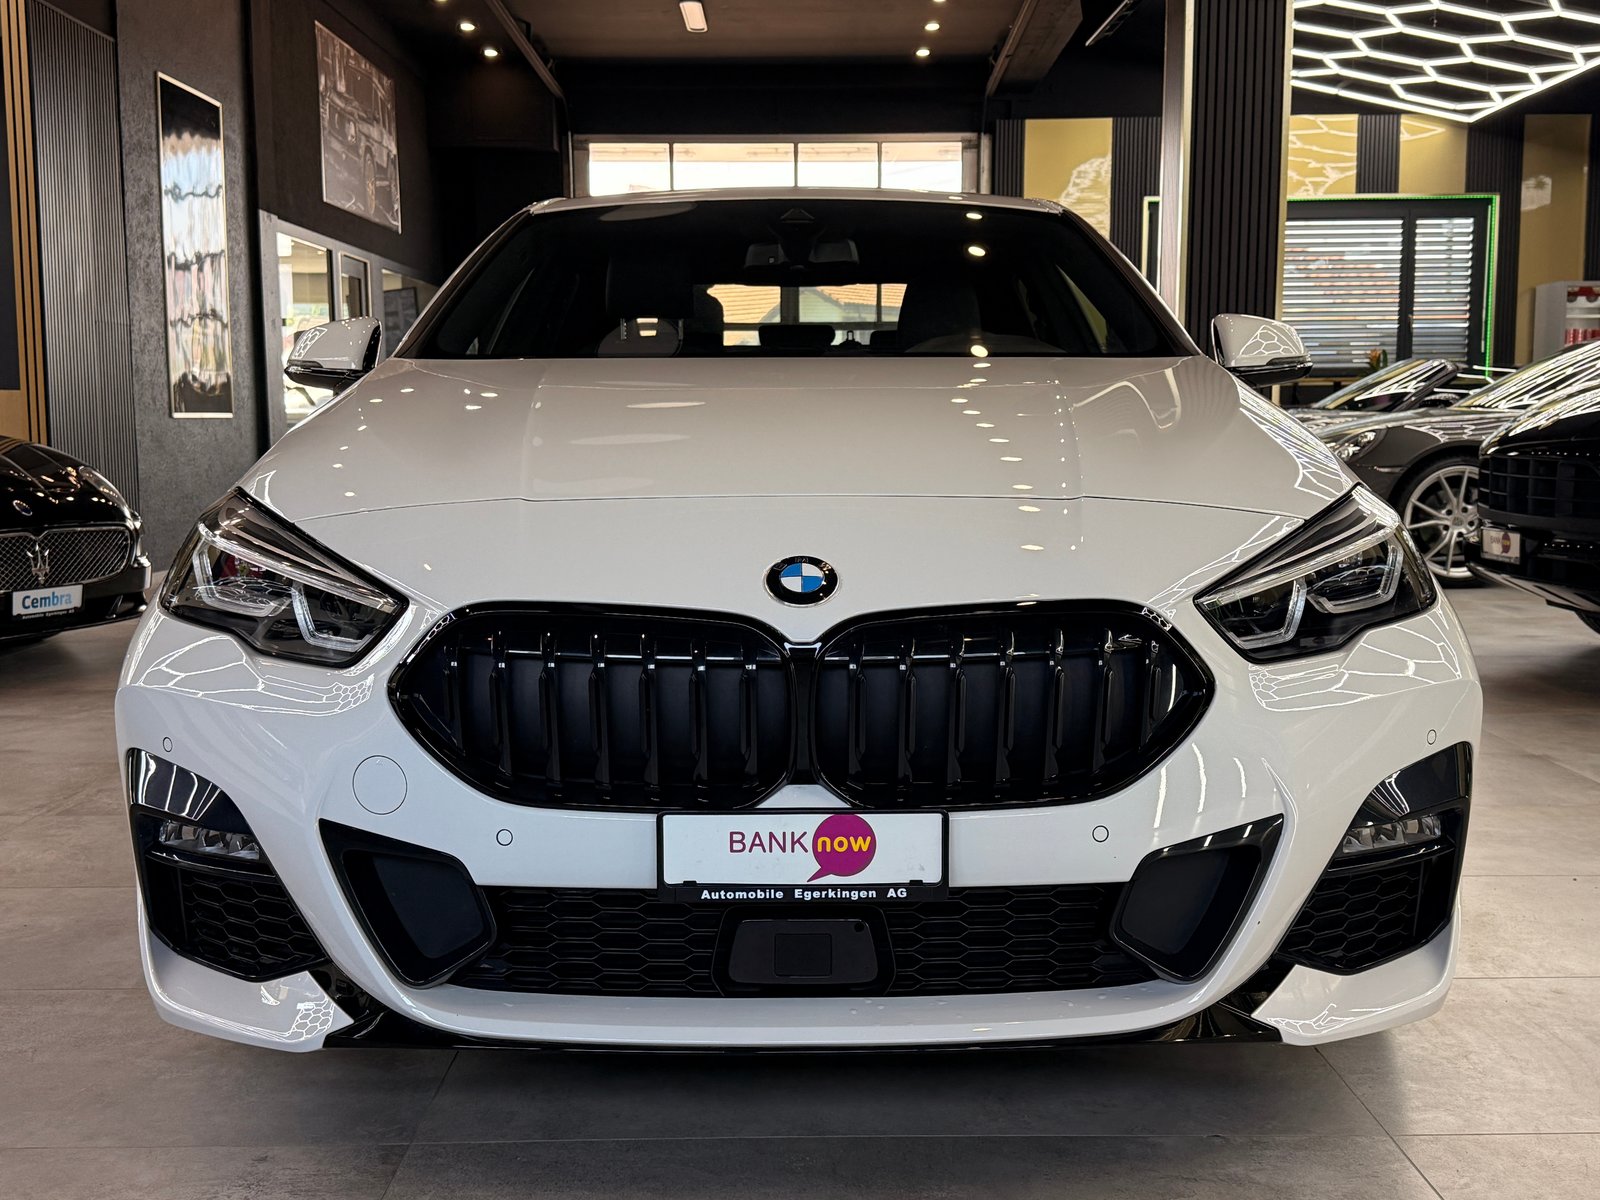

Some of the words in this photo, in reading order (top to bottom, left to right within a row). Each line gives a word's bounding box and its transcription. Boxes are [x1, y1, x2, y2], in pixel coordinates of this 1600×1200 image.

[22, 591, 72, 609] Cembra
[729, 831, 809, 853] BANK
[817, 836, 871, 852] now
[701, 889, 784, 899] Automobile
[794, 889, 877, 900] Egerkingen
[887, 888, 907, 898] AG
